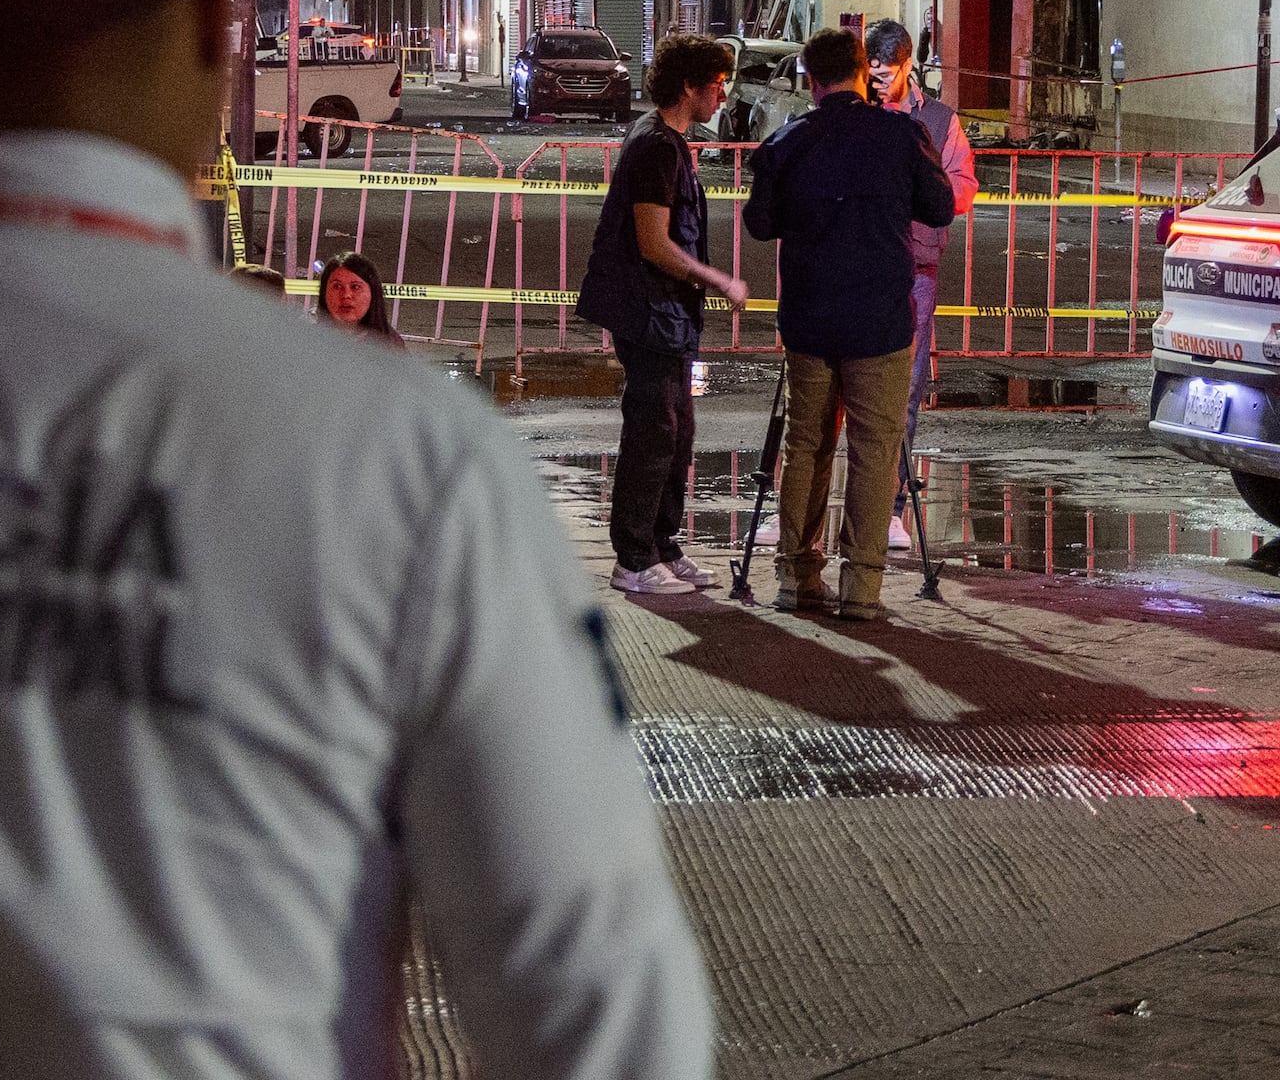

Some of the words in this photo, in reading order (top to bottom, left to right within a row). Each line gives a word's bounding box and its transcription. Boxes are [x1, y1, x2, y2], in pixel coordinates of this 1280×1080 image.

[359, 173, 439, 186] PRECAUCION
[511, 290, 580, 304] PRECAUCIO
[1170, 331, 1244, 362] HERMOSILLO
